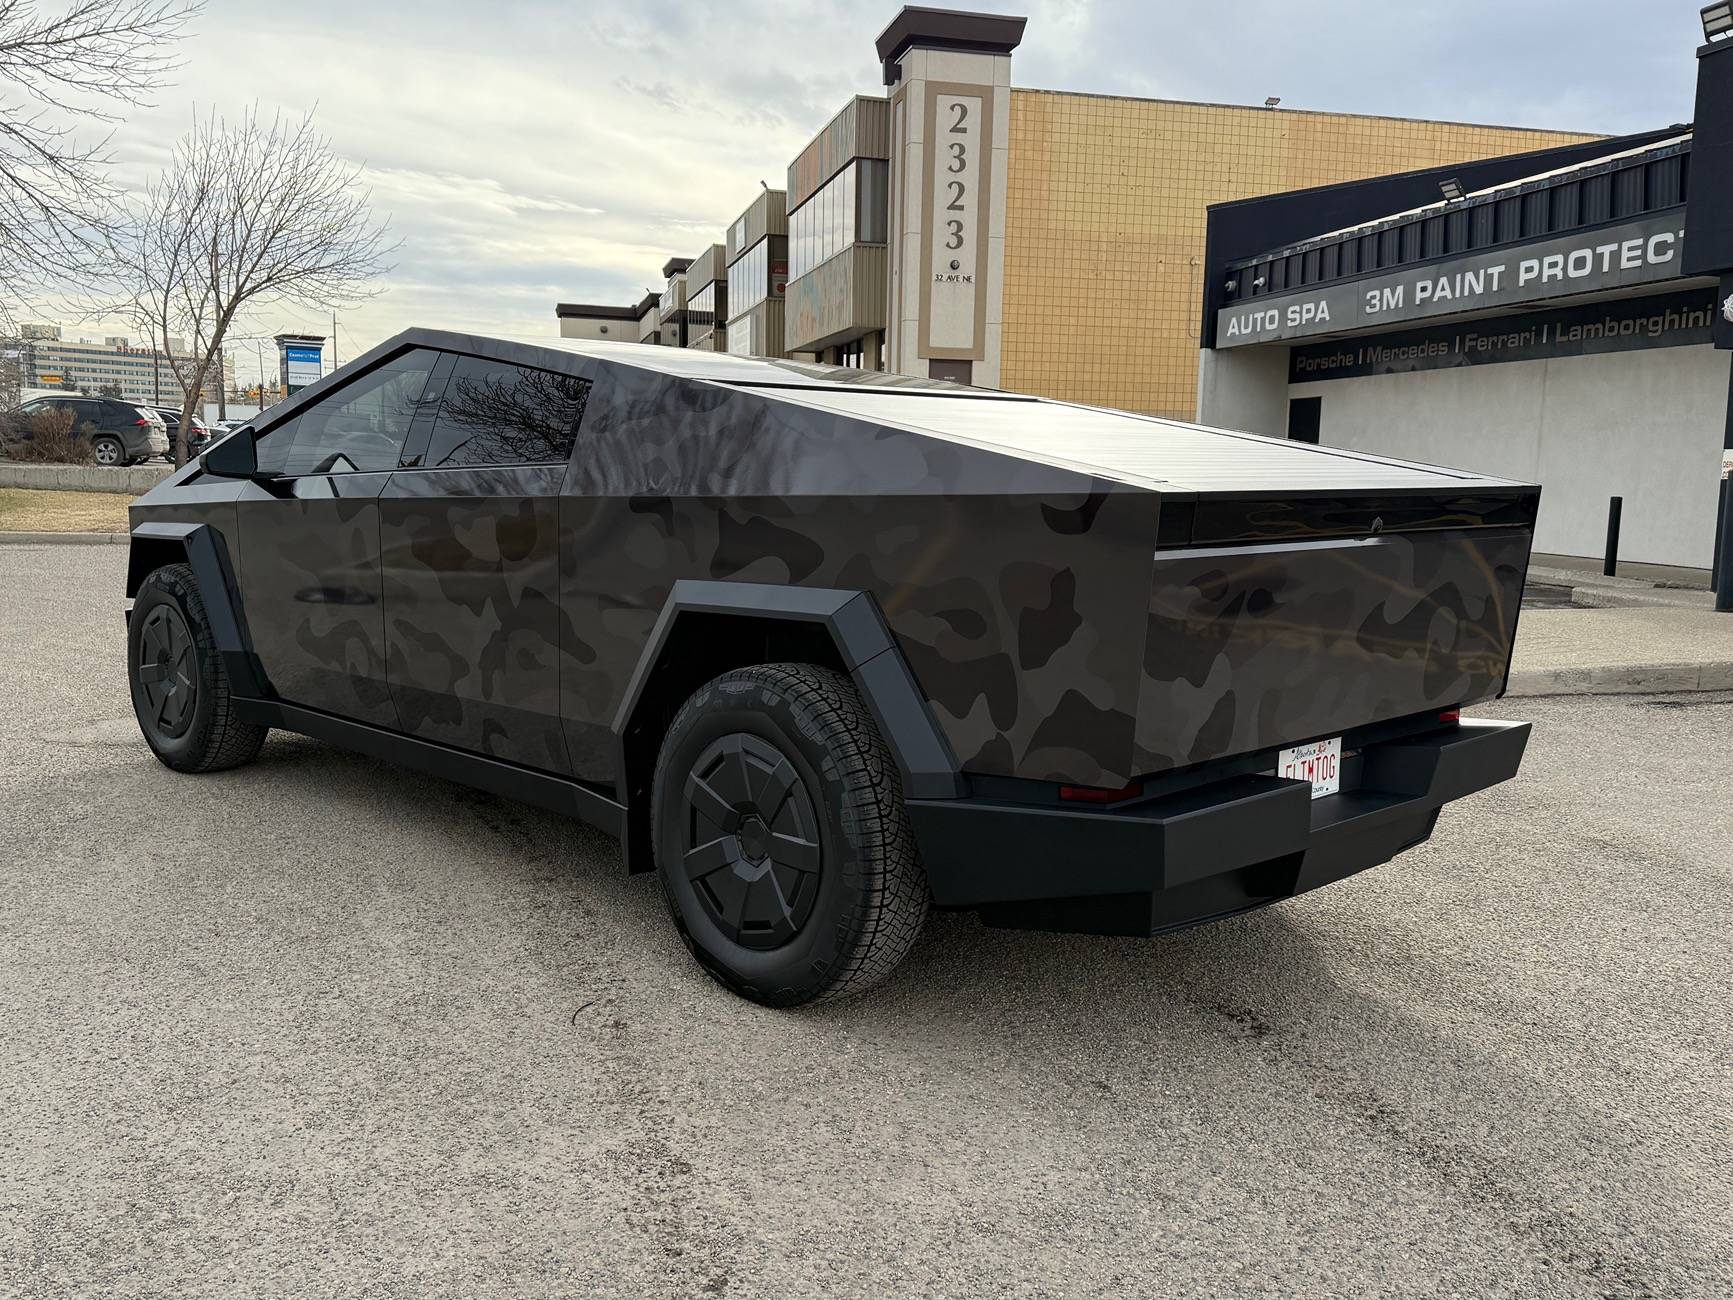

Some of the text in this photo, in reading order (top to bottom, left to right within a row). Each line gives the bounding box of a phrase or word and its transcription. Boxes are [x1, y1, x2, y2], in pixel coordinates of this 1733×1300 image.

[945, 103, 969, 250] 2323
[946, 274, 960, 282] AVE
[962, 275, 973, 283] NE
[1365, 229, 1685, 314] 3M PAINT PROTEC
[1226, 300, 1330, 336] AUTO SPA
[1295, 304, 1713, 372] Porsche Mercedes Ferrari Lamborghini
